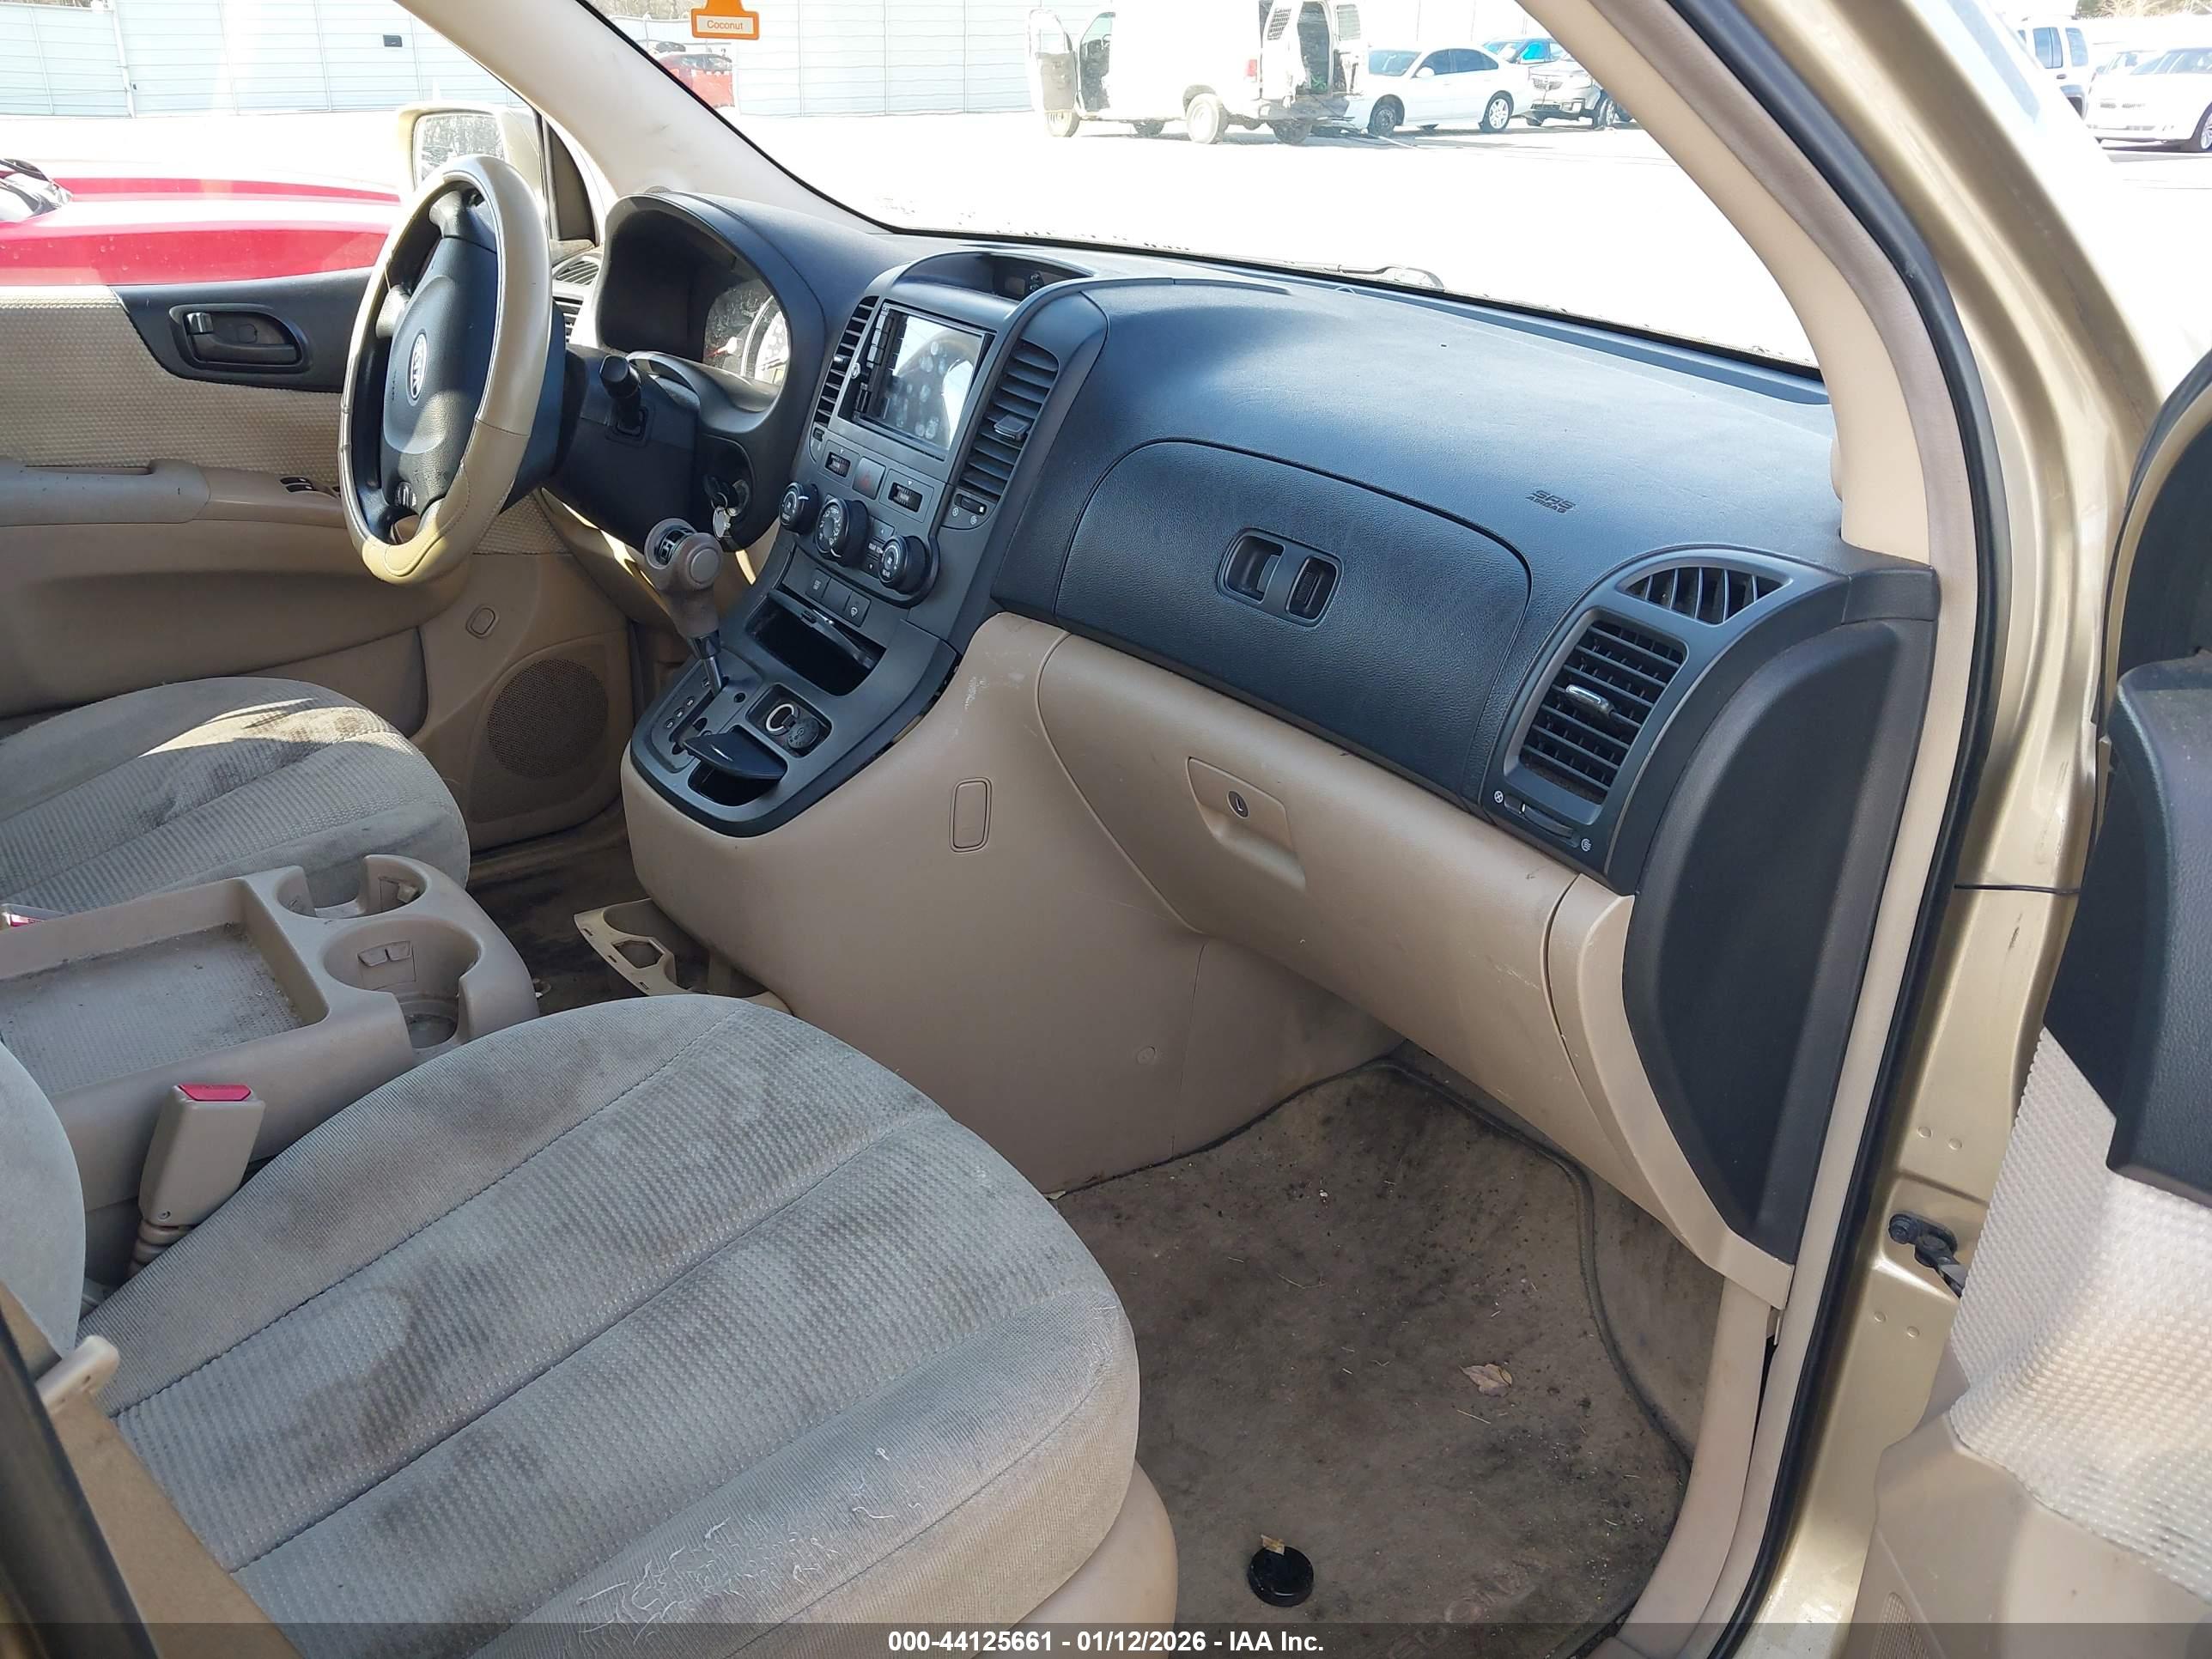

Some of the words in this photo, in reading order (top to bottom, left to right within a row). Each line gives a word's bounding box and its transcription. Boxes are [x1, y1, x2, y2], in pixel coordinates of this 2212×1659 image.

[707, 20, 743, 30] Coconut
[1524, 495, 1568, 514] AIRBAG
[1532, 489, 1577, 510] SRS
